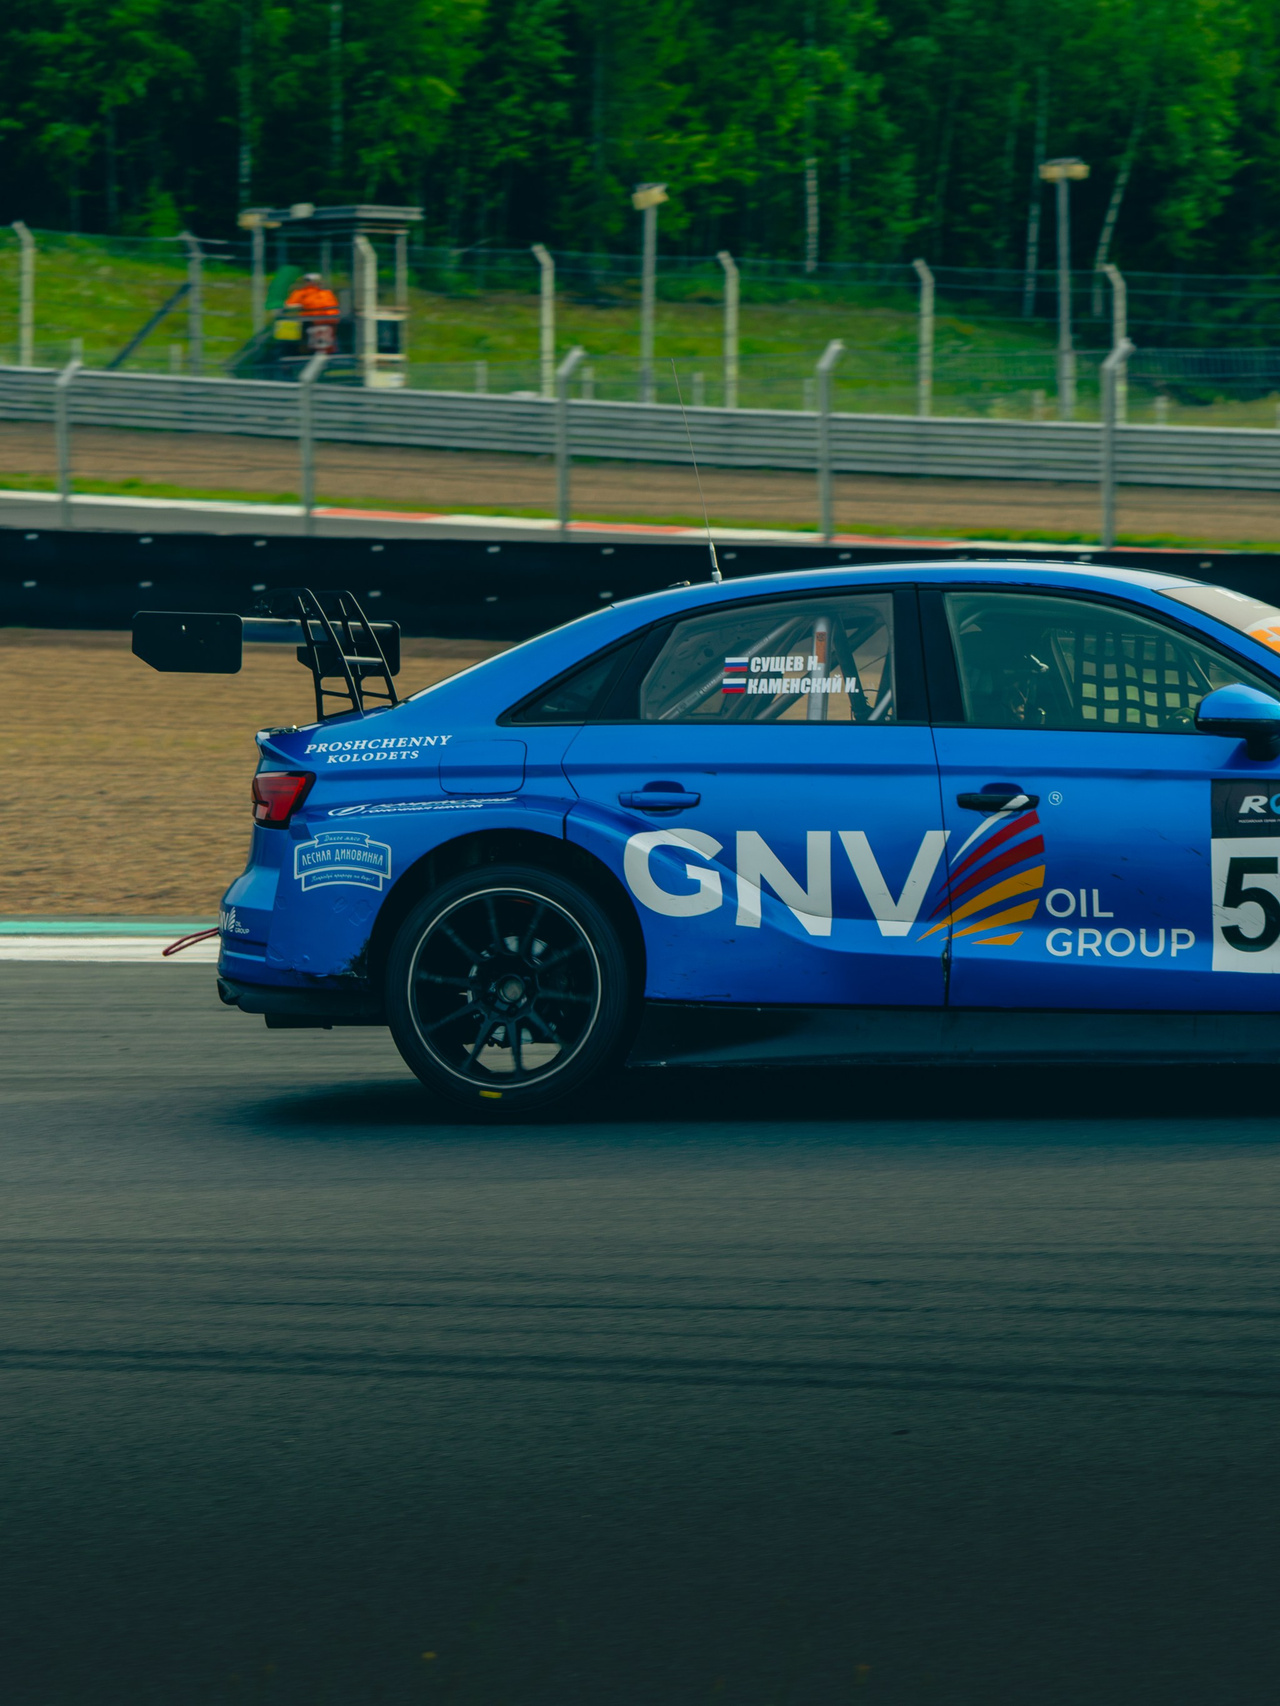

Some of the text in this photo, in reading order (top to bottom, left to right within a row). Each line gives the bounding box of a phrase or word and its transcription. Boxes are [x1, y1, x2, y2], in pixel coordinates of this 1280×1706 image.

[750, 656, 804, 674] СУЩЕВ
[747, 674, 859, 694] КАМЕНСКИЙ И.
[304, 734, 453, 754] PROSHCHENNY
[326, 750, 420, 764] KOLODETS
[302, 848, 384, 867] ЛЕСНАЯ ДИКОВИНКА
[623, 827, 951, 937] GNV
[1045, 888, 1114, 918] OIL
[1045, 928, 1196, 958] GROUP
